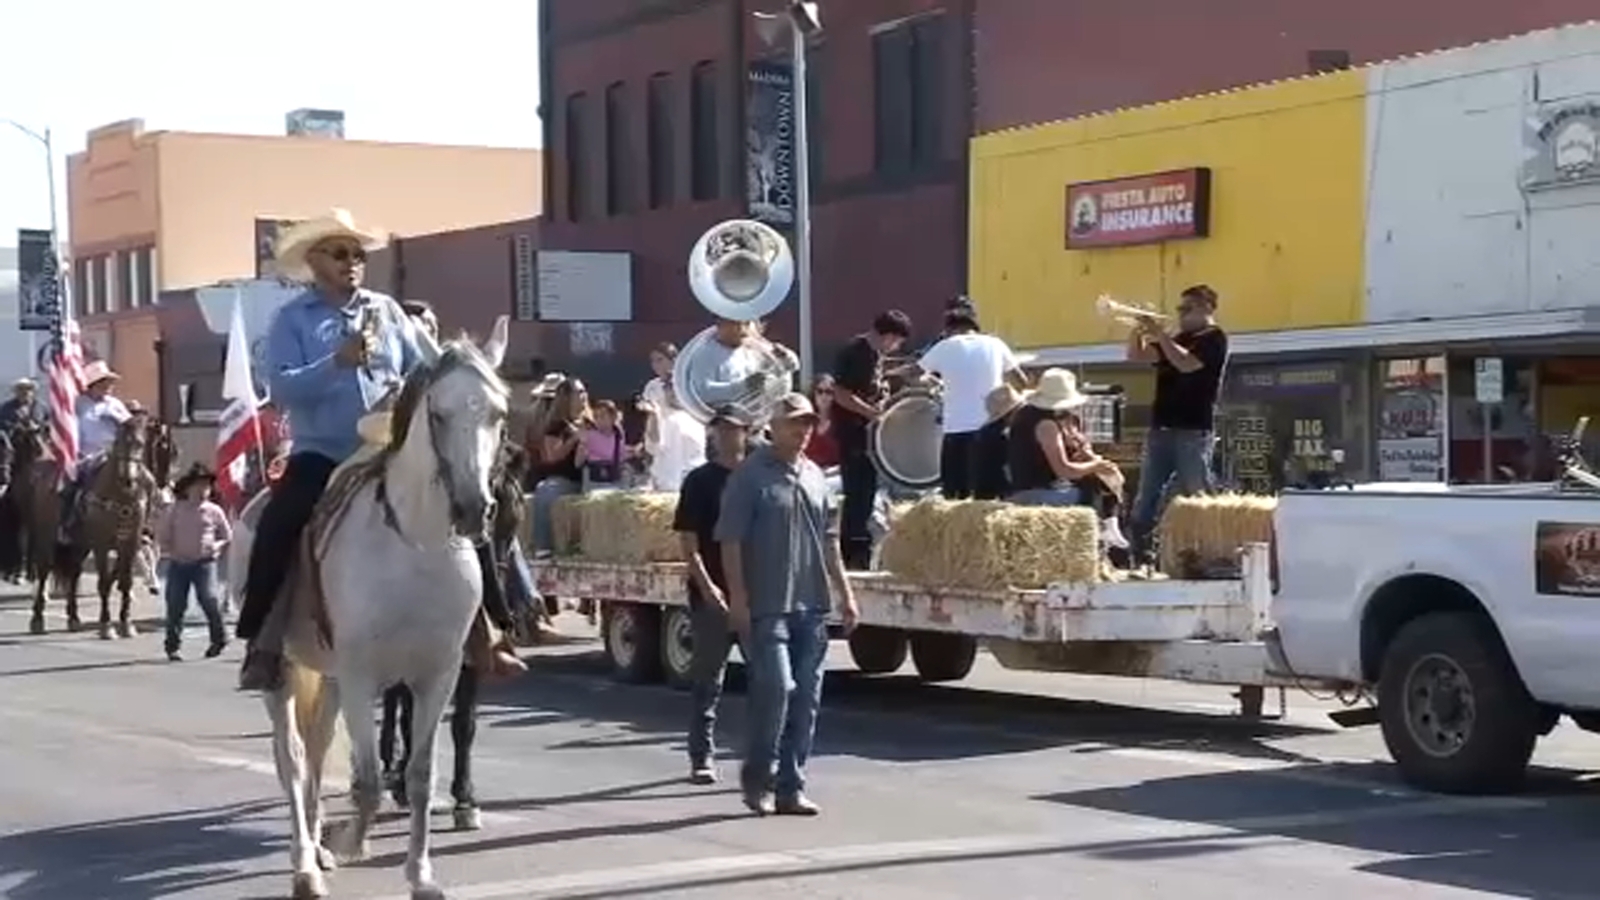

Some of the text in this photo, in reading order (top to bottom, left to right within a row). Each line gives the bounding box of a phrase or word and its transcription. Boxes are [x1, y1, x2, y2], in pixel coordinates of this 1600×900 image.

[777, 91, 792, 209] DOWNTOWN
[1149, 184, 1186, 204] AUTO
[1102, 203, 1194, 231] INSURANCE
[1293, 439, 1326, 457] TAX
